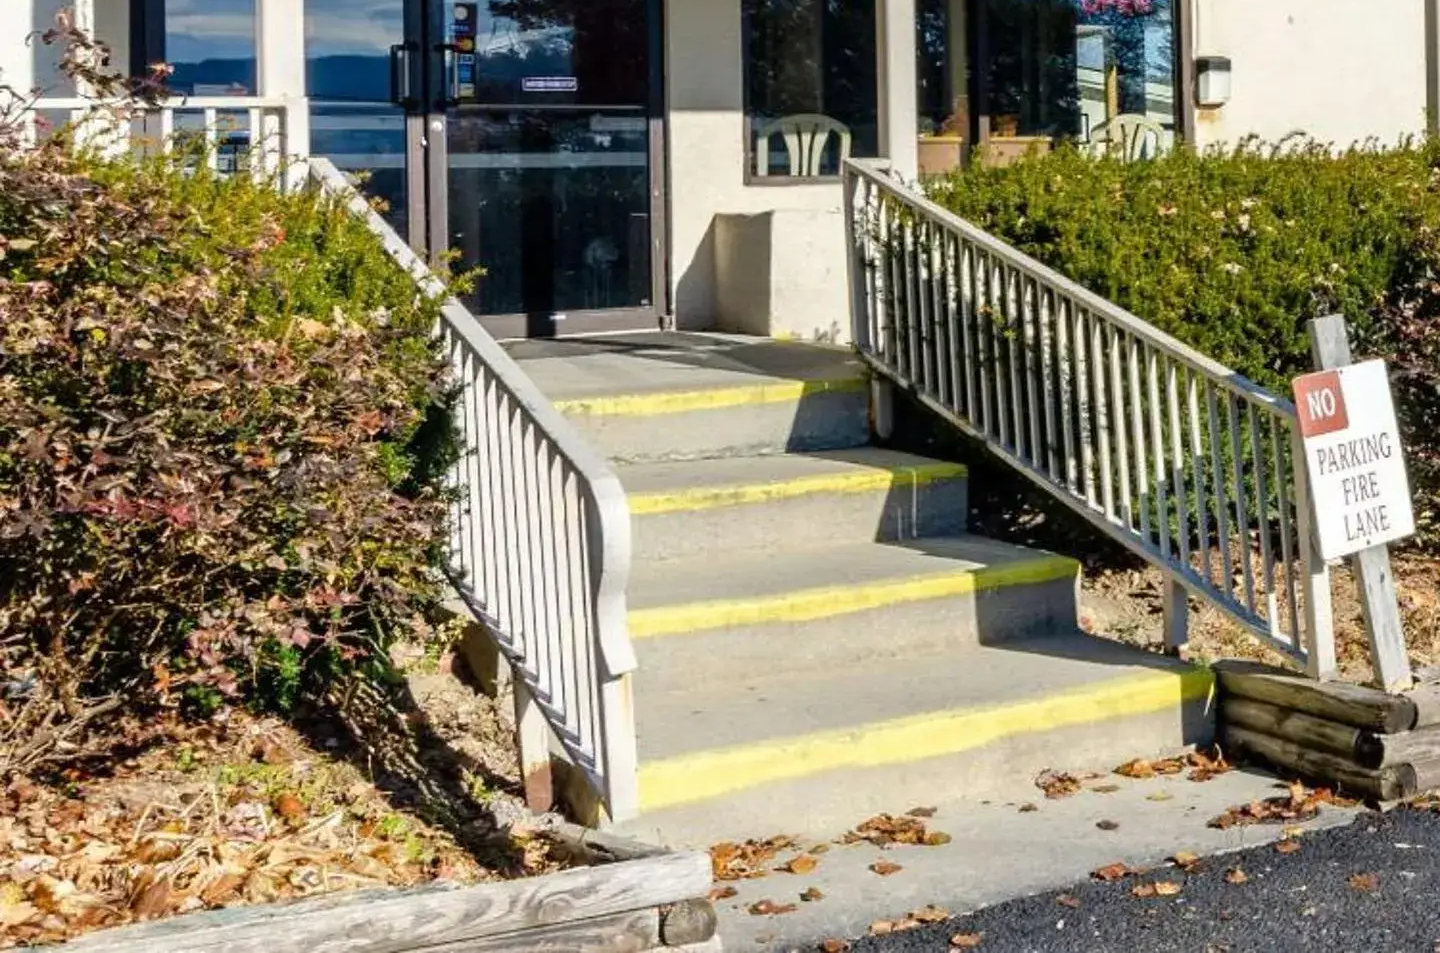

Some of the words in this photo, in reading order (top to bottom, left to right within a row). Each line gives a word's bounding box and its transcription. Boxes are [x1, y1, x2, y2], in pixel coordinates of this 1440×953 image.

[1306, 387, 1336, 421] NO
[1316, 432, 1392, 476] PARKING
[1341, 472, 1380, 506] FIRE
[1344, 504, 1391, 541] LANE
